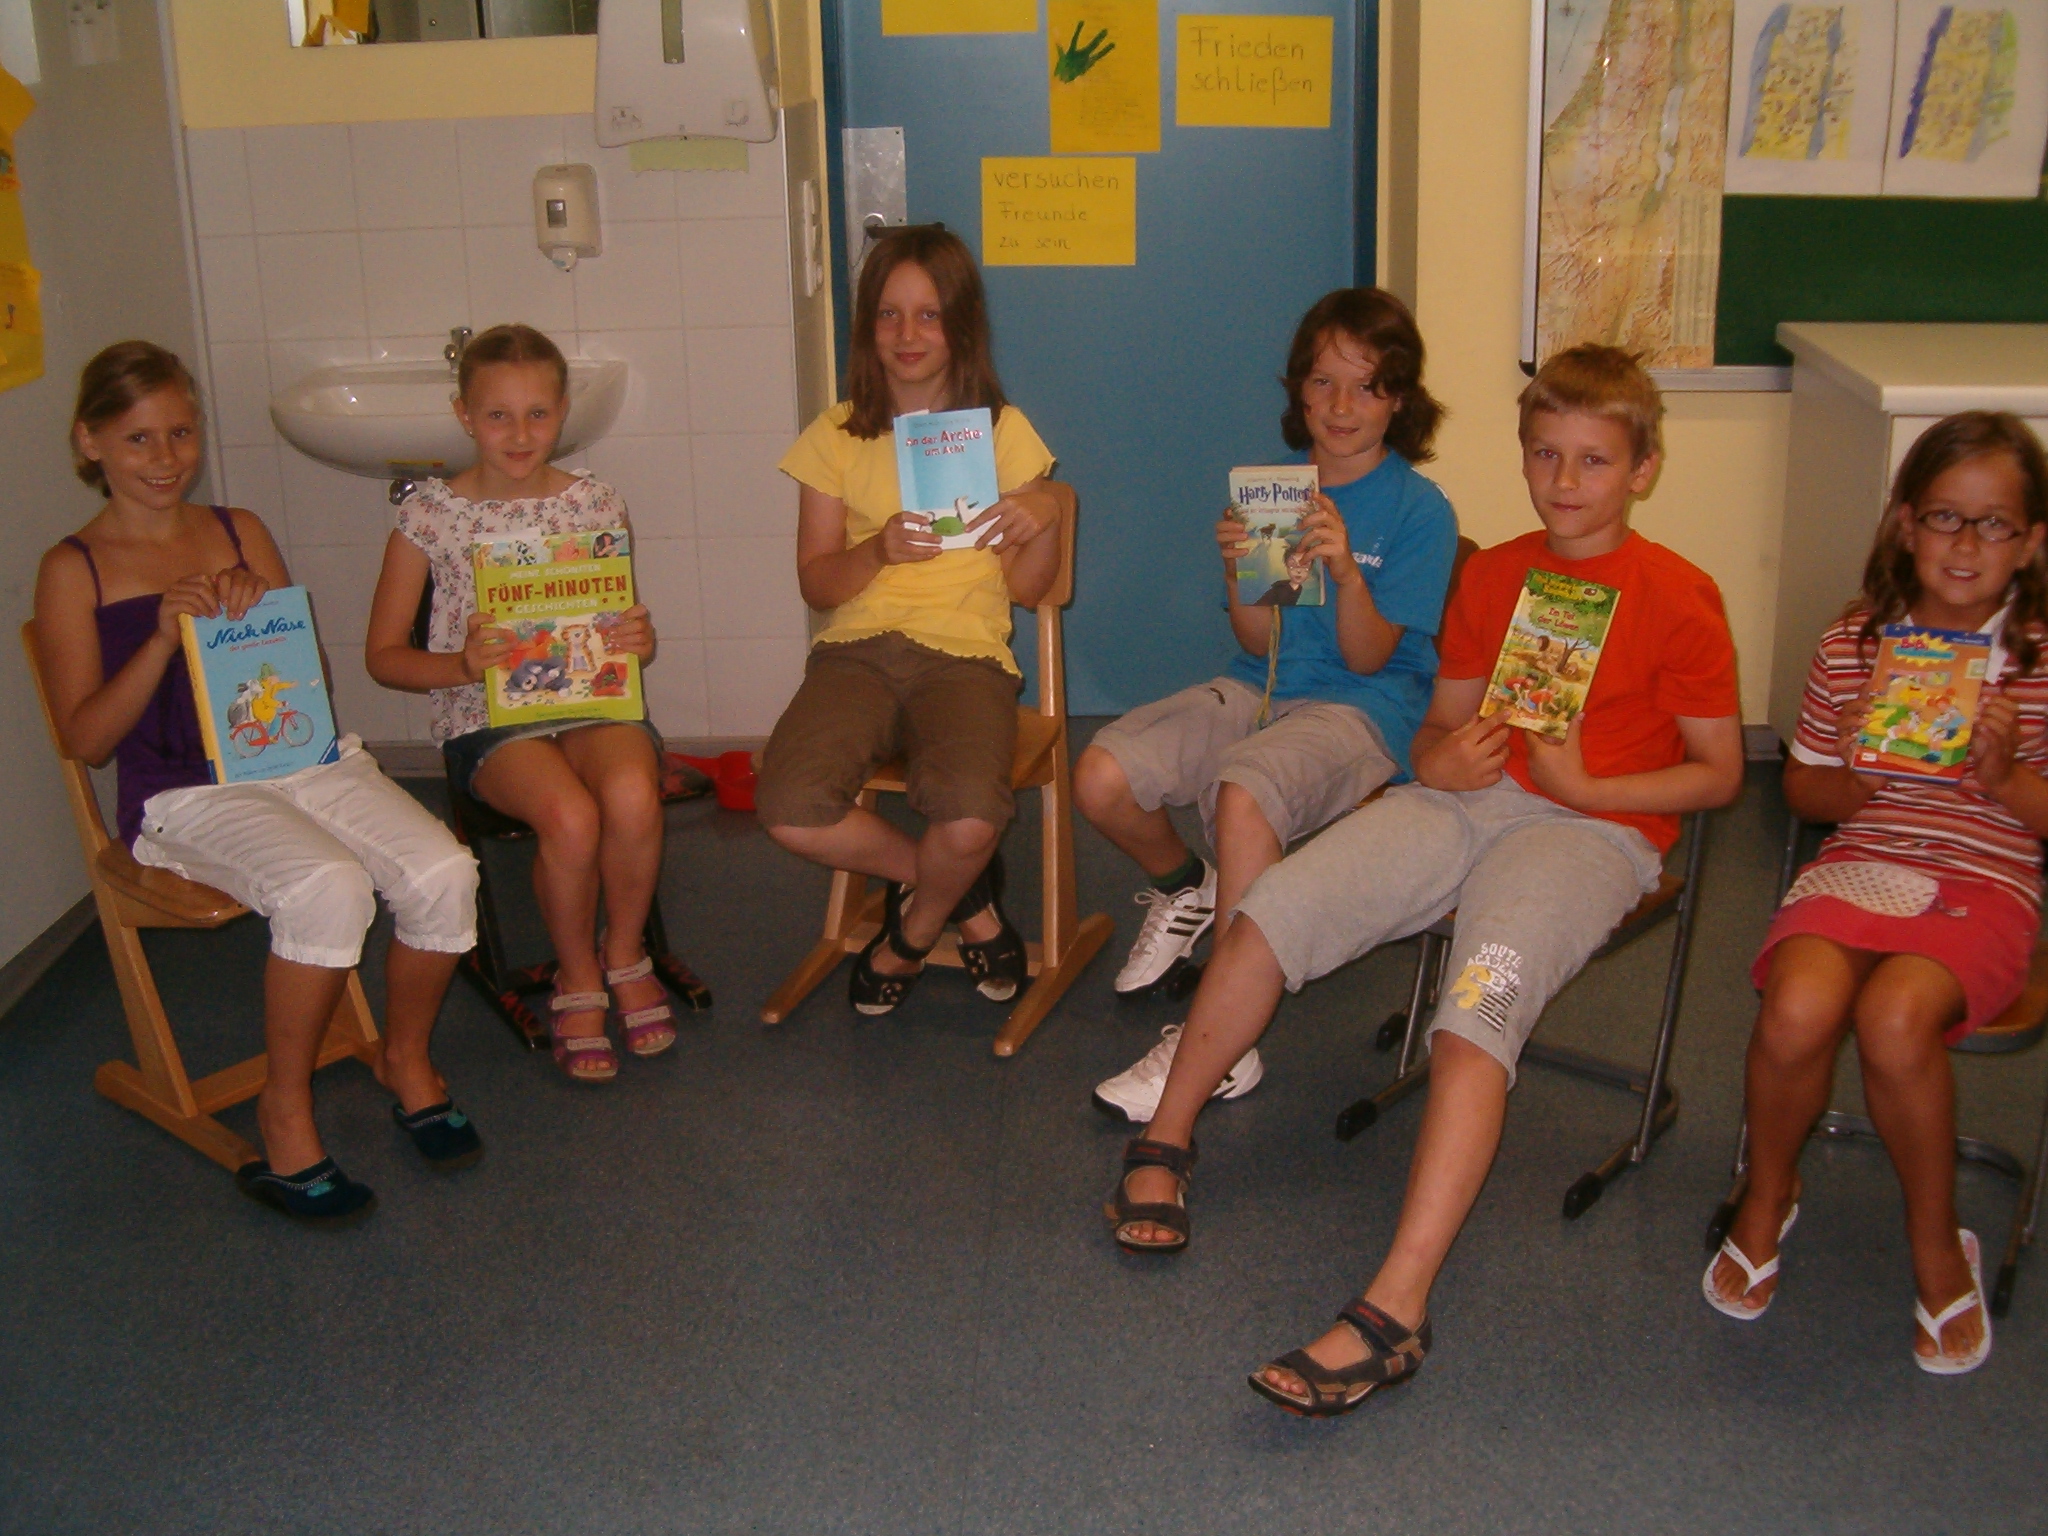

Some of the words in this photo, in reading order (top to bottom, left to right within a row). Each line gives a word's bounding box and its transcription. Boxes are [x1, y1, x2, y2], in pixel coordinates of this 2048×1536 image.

[1190, 26, 1305, 60] Frieden
[1191, 66, 1314, 105] schließen
[993, 169, 1120, 191] versuchen
[1000, 201, 1088, 222] Freunde
[999, 236, 1021, 250] zu
[1034, 233, 1071, 250] sein
[921, 435, 938, 446] der
[940, 427, 983, 443] Arche
[943, 443, 965, 455] Acht
[1239, 485, 1271, 505] Harry
[1272, 483, 1310, 506] Potter
[514, 599, 599, 615] GESCHICHTEN
[207, 624, 259, 650] Nick
[261, 617, 306, 636] Nase
